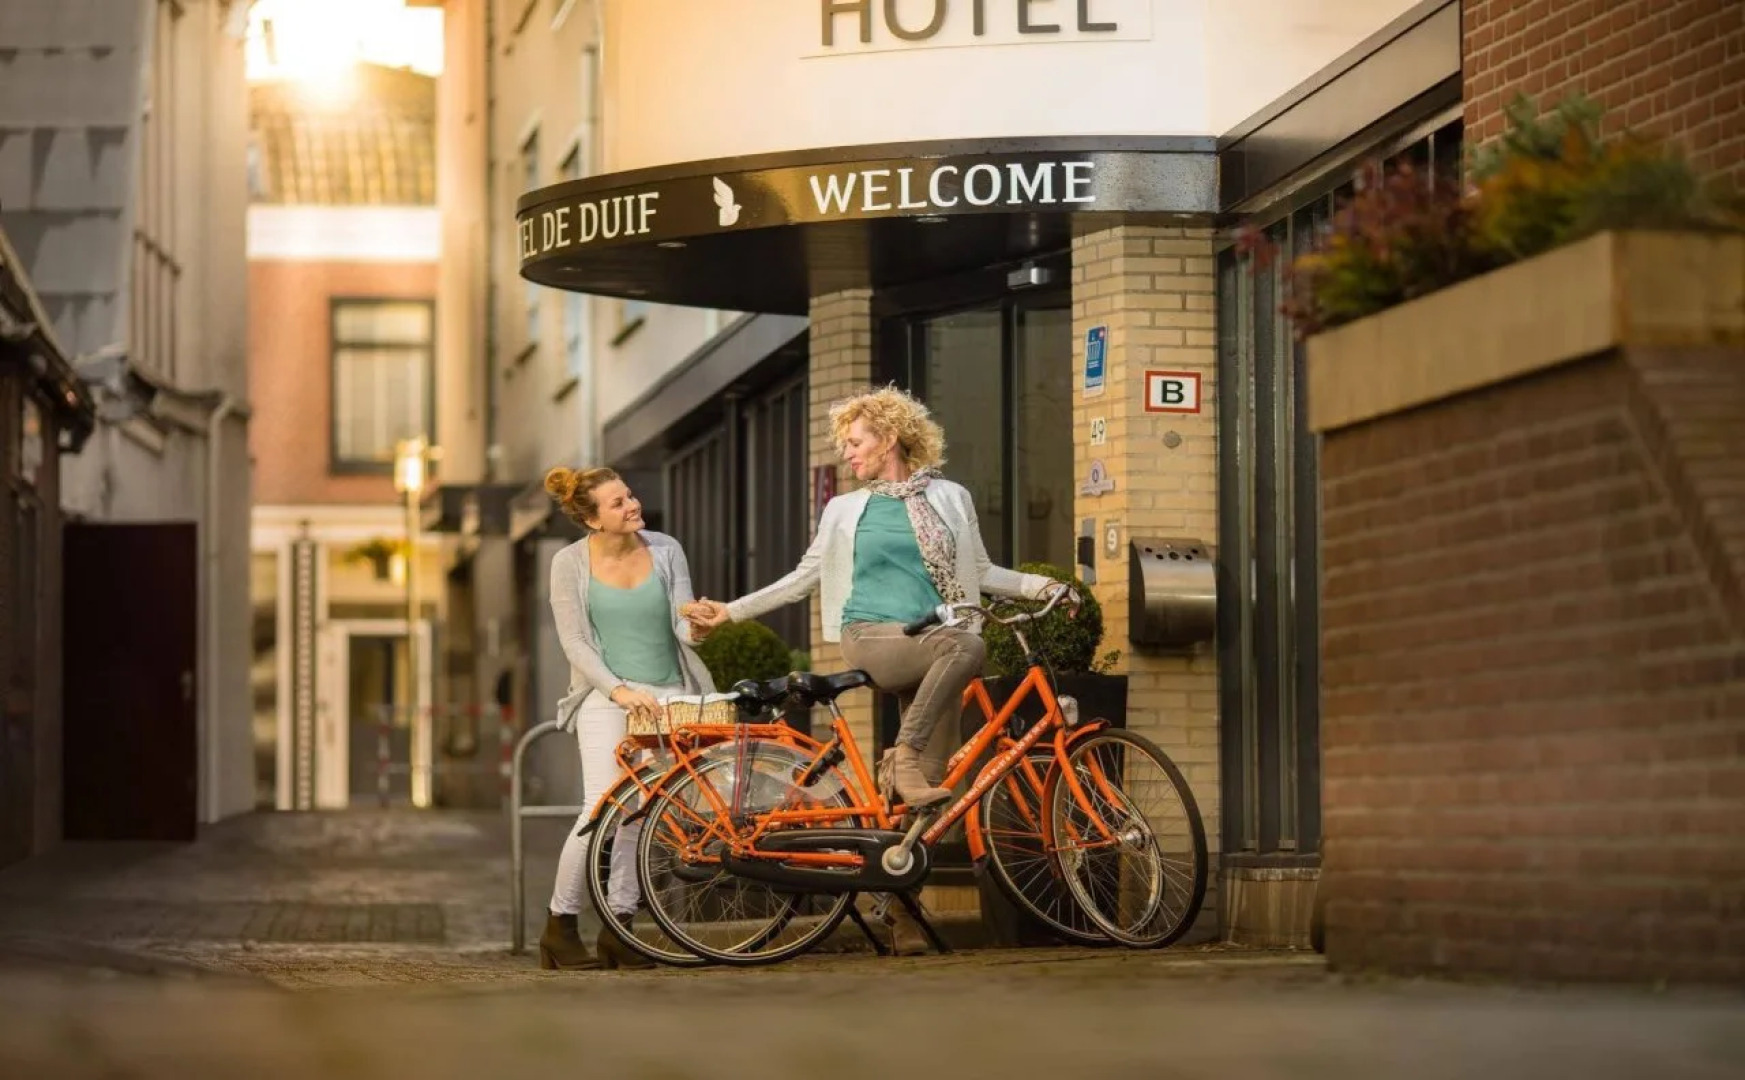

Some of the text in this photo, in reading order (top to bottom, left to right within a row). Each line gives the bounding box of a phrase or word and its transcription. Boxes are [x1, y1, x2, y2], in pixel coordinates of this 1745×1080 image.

[809, 161, 1097, 215] WELCOME
[518, 191, 659, 260] EL DE DUIF
[1161, 380, 1184, 404] B
[1091, 420, 1105, 443] 49
